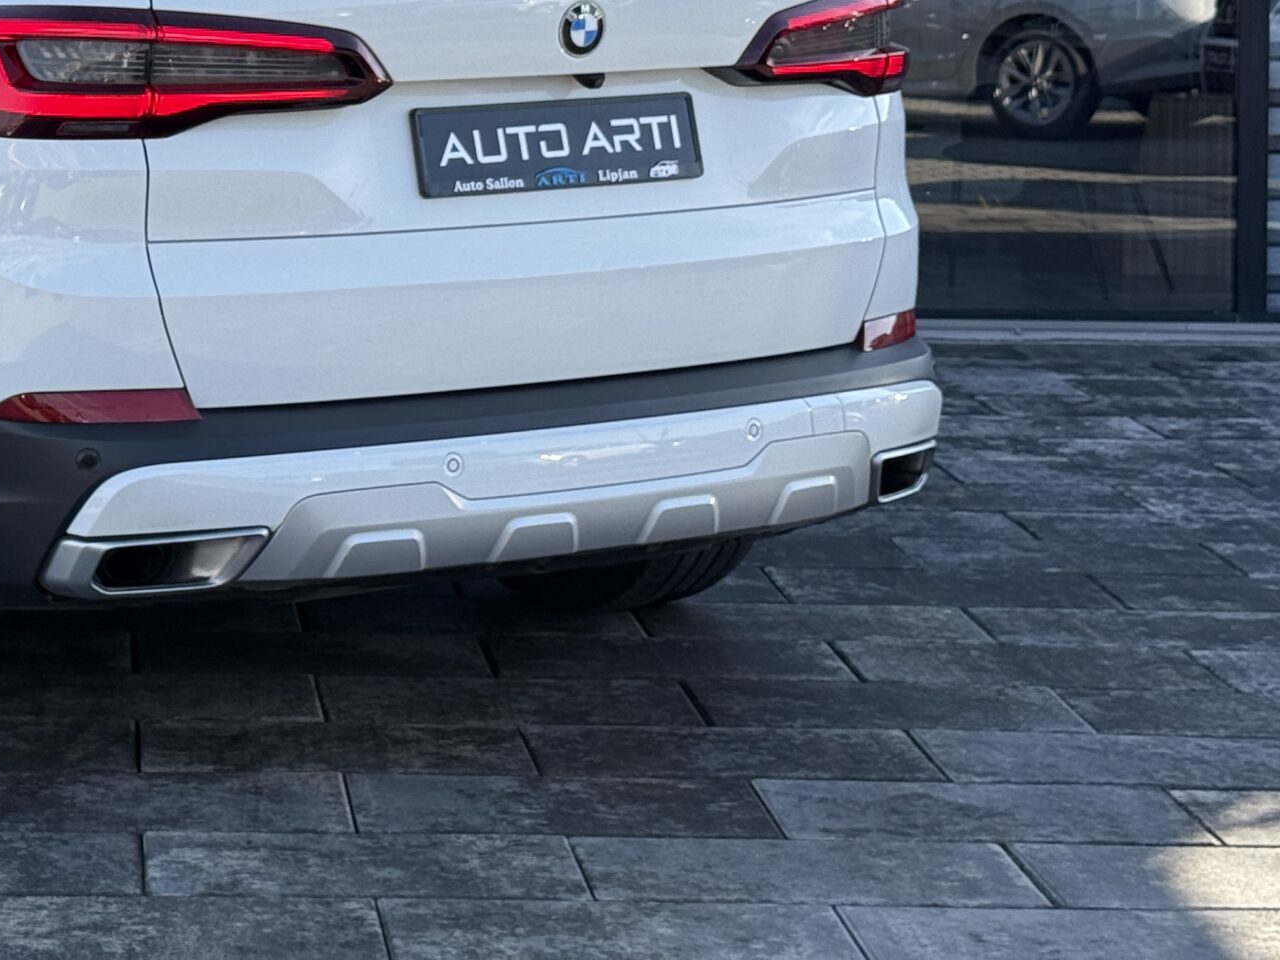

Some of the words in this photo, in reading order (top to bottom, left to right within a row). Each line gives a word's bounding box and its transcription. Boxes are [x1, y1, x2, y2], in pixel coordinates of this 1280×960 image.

[440, 123, 570, 167] AUTO
[582, 114, 681, 156] ARTI
[454, 180, 484, 192] Auto
[486, 177, 524, 190] Sallon
[537, 171, 586, 187] ARTI
[598, 169, 638, 182] Lipjan
